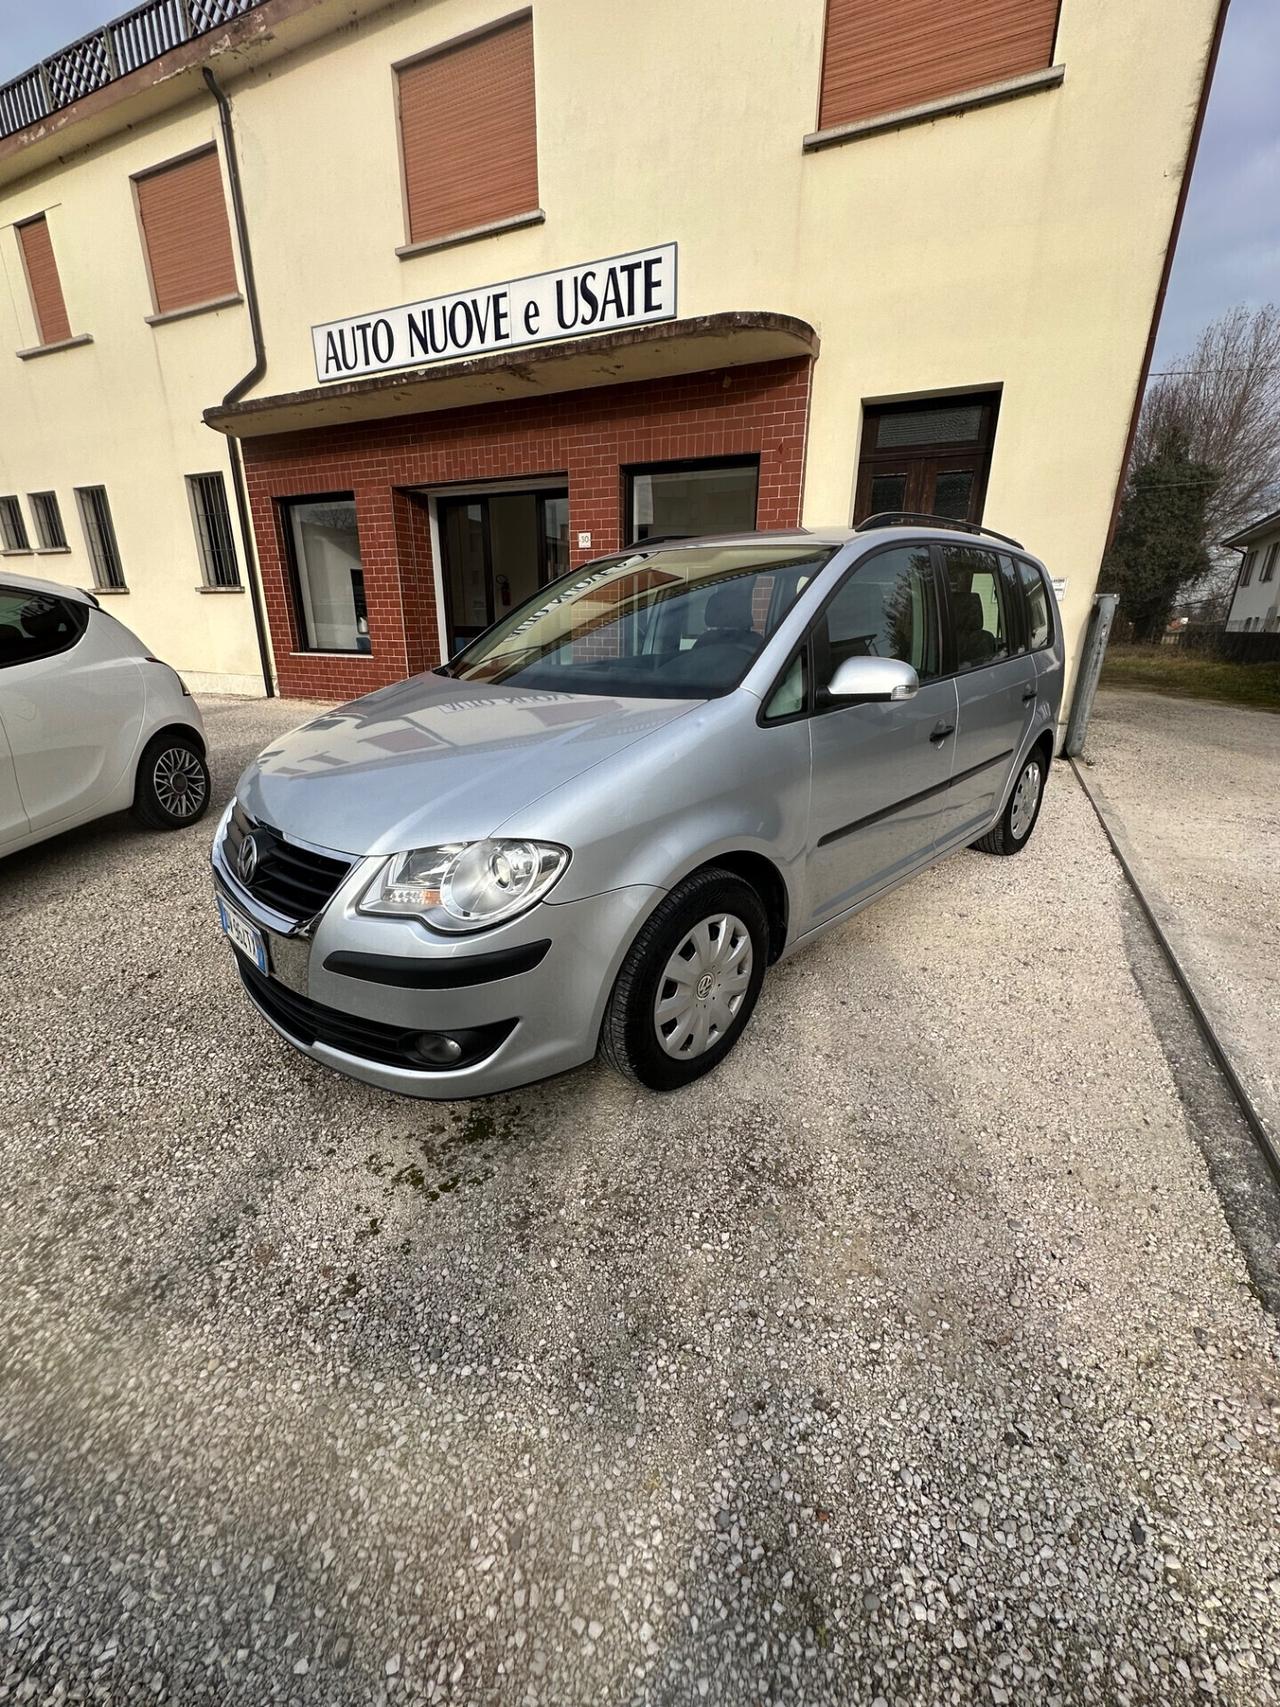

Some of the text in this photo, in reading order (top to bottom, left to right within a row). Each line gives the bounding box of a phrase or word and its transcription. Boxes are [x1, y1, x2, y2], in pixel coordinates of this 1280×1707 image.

[324, 256, 663, 374] AUTO NUOVE e USATE
